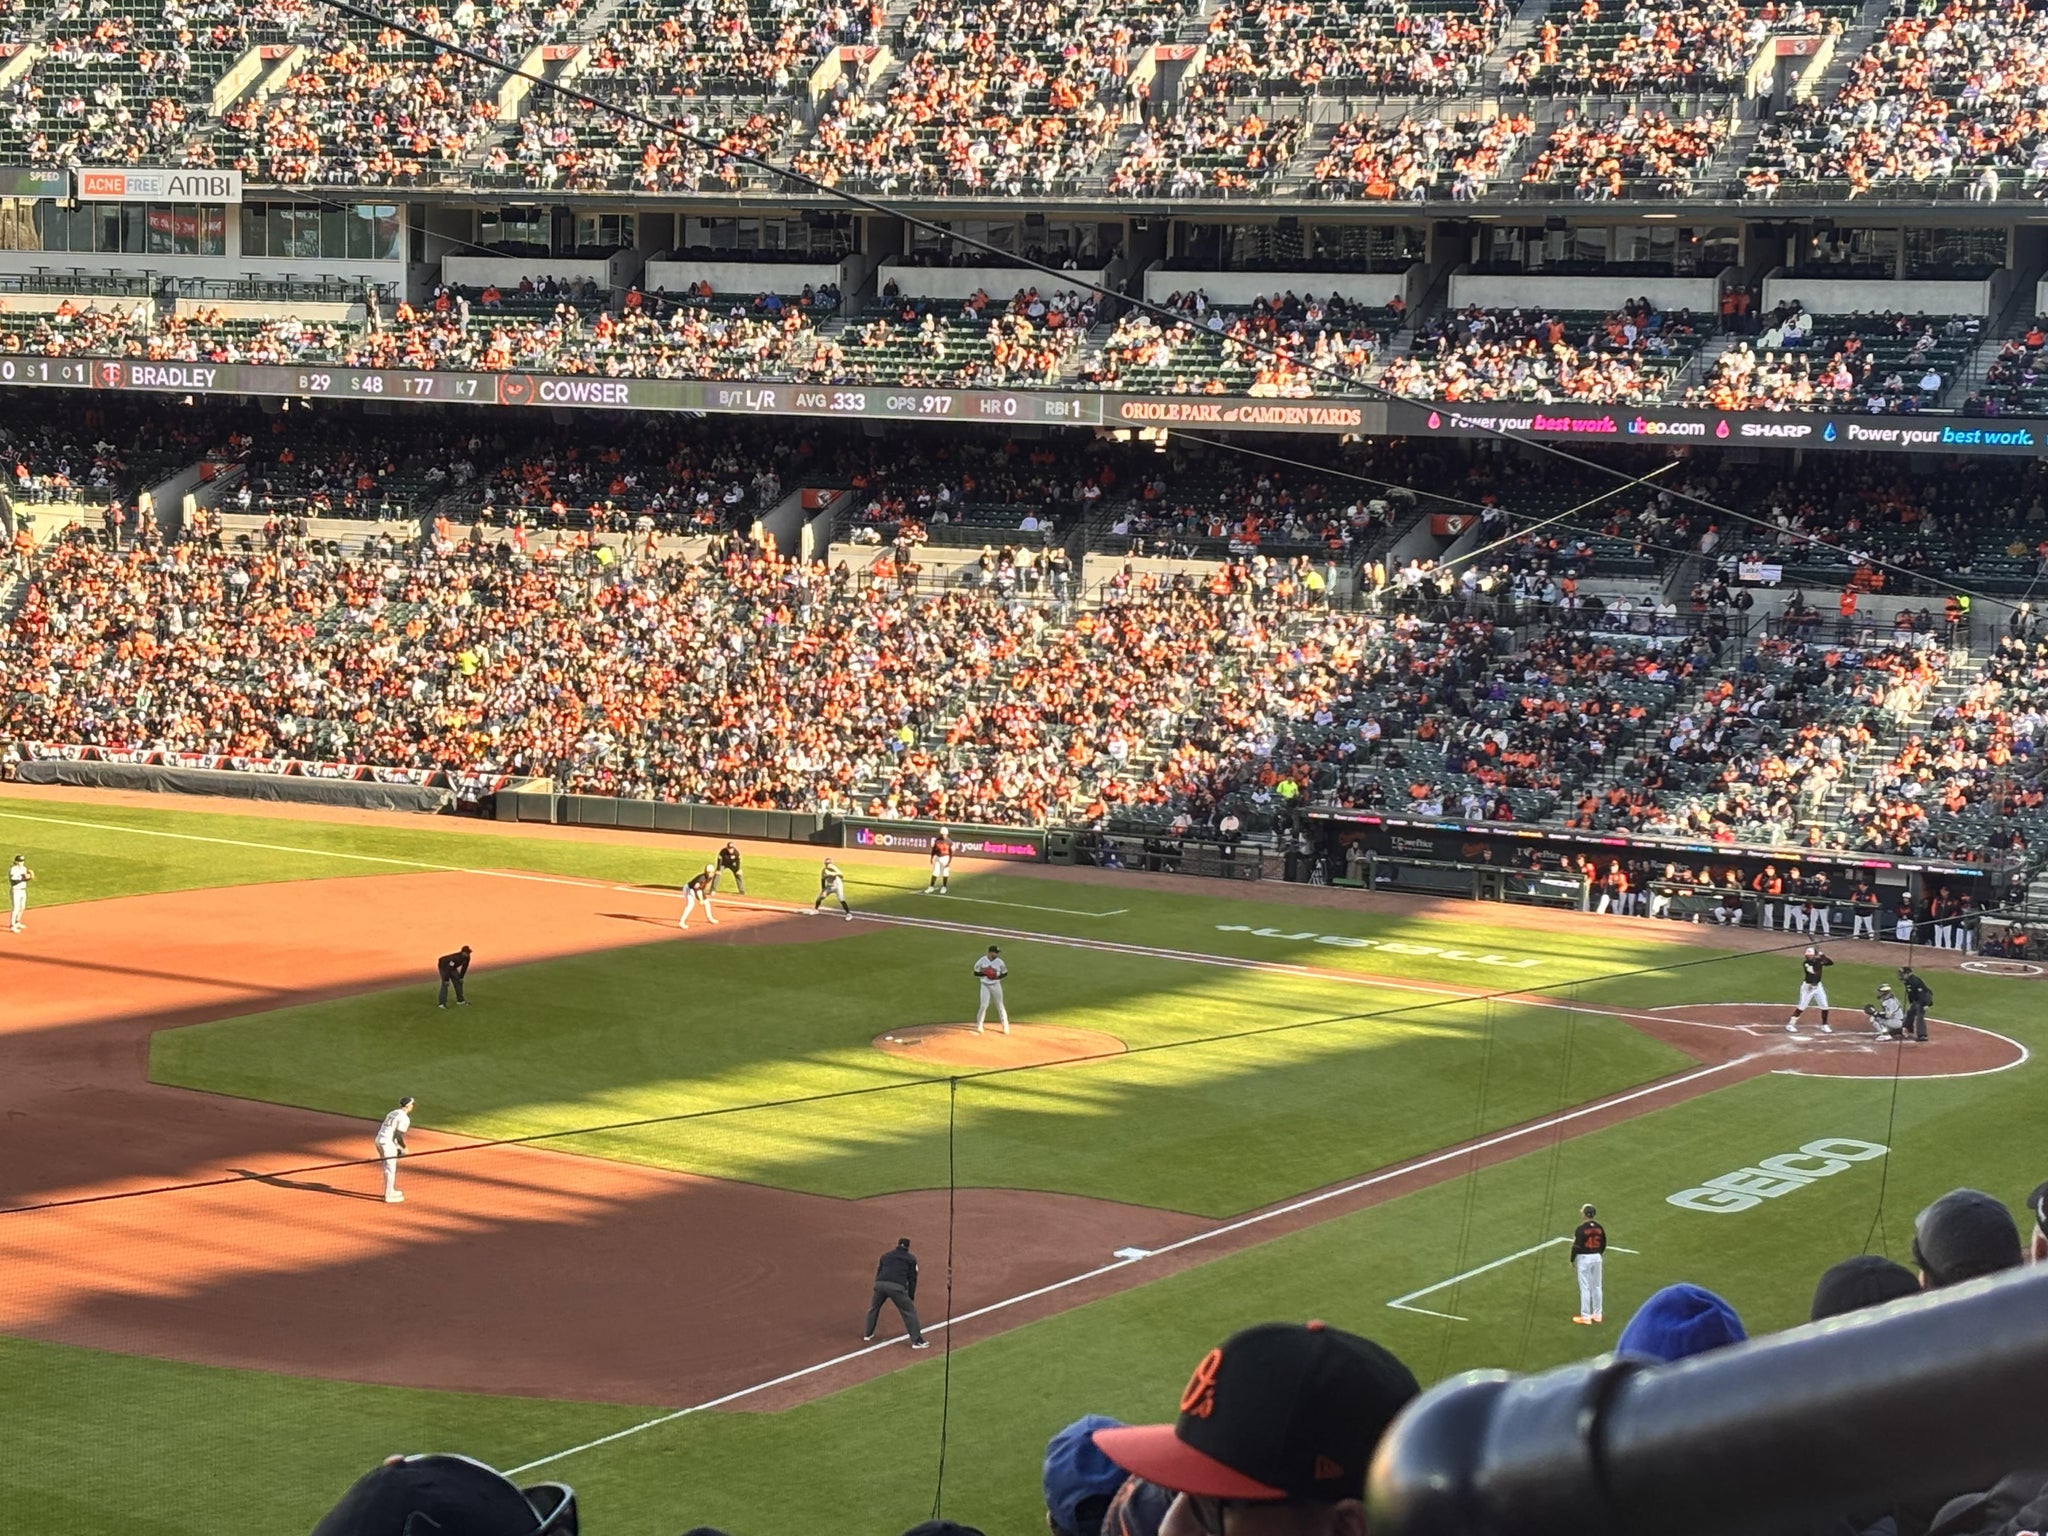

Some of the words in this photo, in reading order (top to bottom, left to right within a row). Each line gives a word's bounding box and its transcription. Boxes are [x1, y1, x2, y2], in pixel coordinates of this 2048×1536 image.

[29, 171, 60, 182] SPEED
[87, 178, 122, 191] ACNE
[126, 177, 159, 192] FREE
[168, 176, 231, 197] AMBI
[2, 361, 16, 380] 0
[27, 366, 36, 378] S
[39, 362, 48, 381] 1
[75, 364, 84, 382] 1
[132, 366, 216, 388] BRADLEY
[299, 376, 308, 389] B
[310, 374, 331, 391] 29
[351, 377, 360, 390] S
[361, 376, 384, 393] 48
[403, 379, 412, 393] T
[414, 378, 434, 395] 77
[456, 381, 464, 394] K
[466, 380, 478, 396] 7
[539, 381, 629, 404] COWSER
[719, 390, 743, 407] B/T
[746, 390, 776, 411] L/R
[796, 393, 827, 408] AVG
[829, 392, 866, 411] .333
[886, 396, 916, 411] OPS
[918, 395, 952, 414] .917
[980, 401, 1001, 414] HR
[1004, 398, 1017, 416] 0
[1045, 401, 1069, 416] RBI
[1072, 400, 1081, 418] 1
[1121, 402, 1180, 420] ORIOLE
[1181, 404, 1222, 422] PARK
[1239, 406, 1309, 425] CAMDEN
[1309, 408, 1362, 426] YARDS
[1450, 413, 1495, 429] Power
[1499, 419, 1533, 433] your
[1534, 414, 1571, 432] best
[1571, 416, 1618, 433] work.
[1628, 416, 1706, 436] ubeo.com
[1741, 423, 1812, 438] SHARP
[1848, 424, 1898, 441] Power
[1901, 430, 1940, 446] your
[1942, 427, 1982, 443] best
[1985, 429, 2035, 446] work.
[856, 828, 893, 846] ubeo
[961, 842, 984, 852] your
[1666, 1138, 1891, 1213] GEICO
